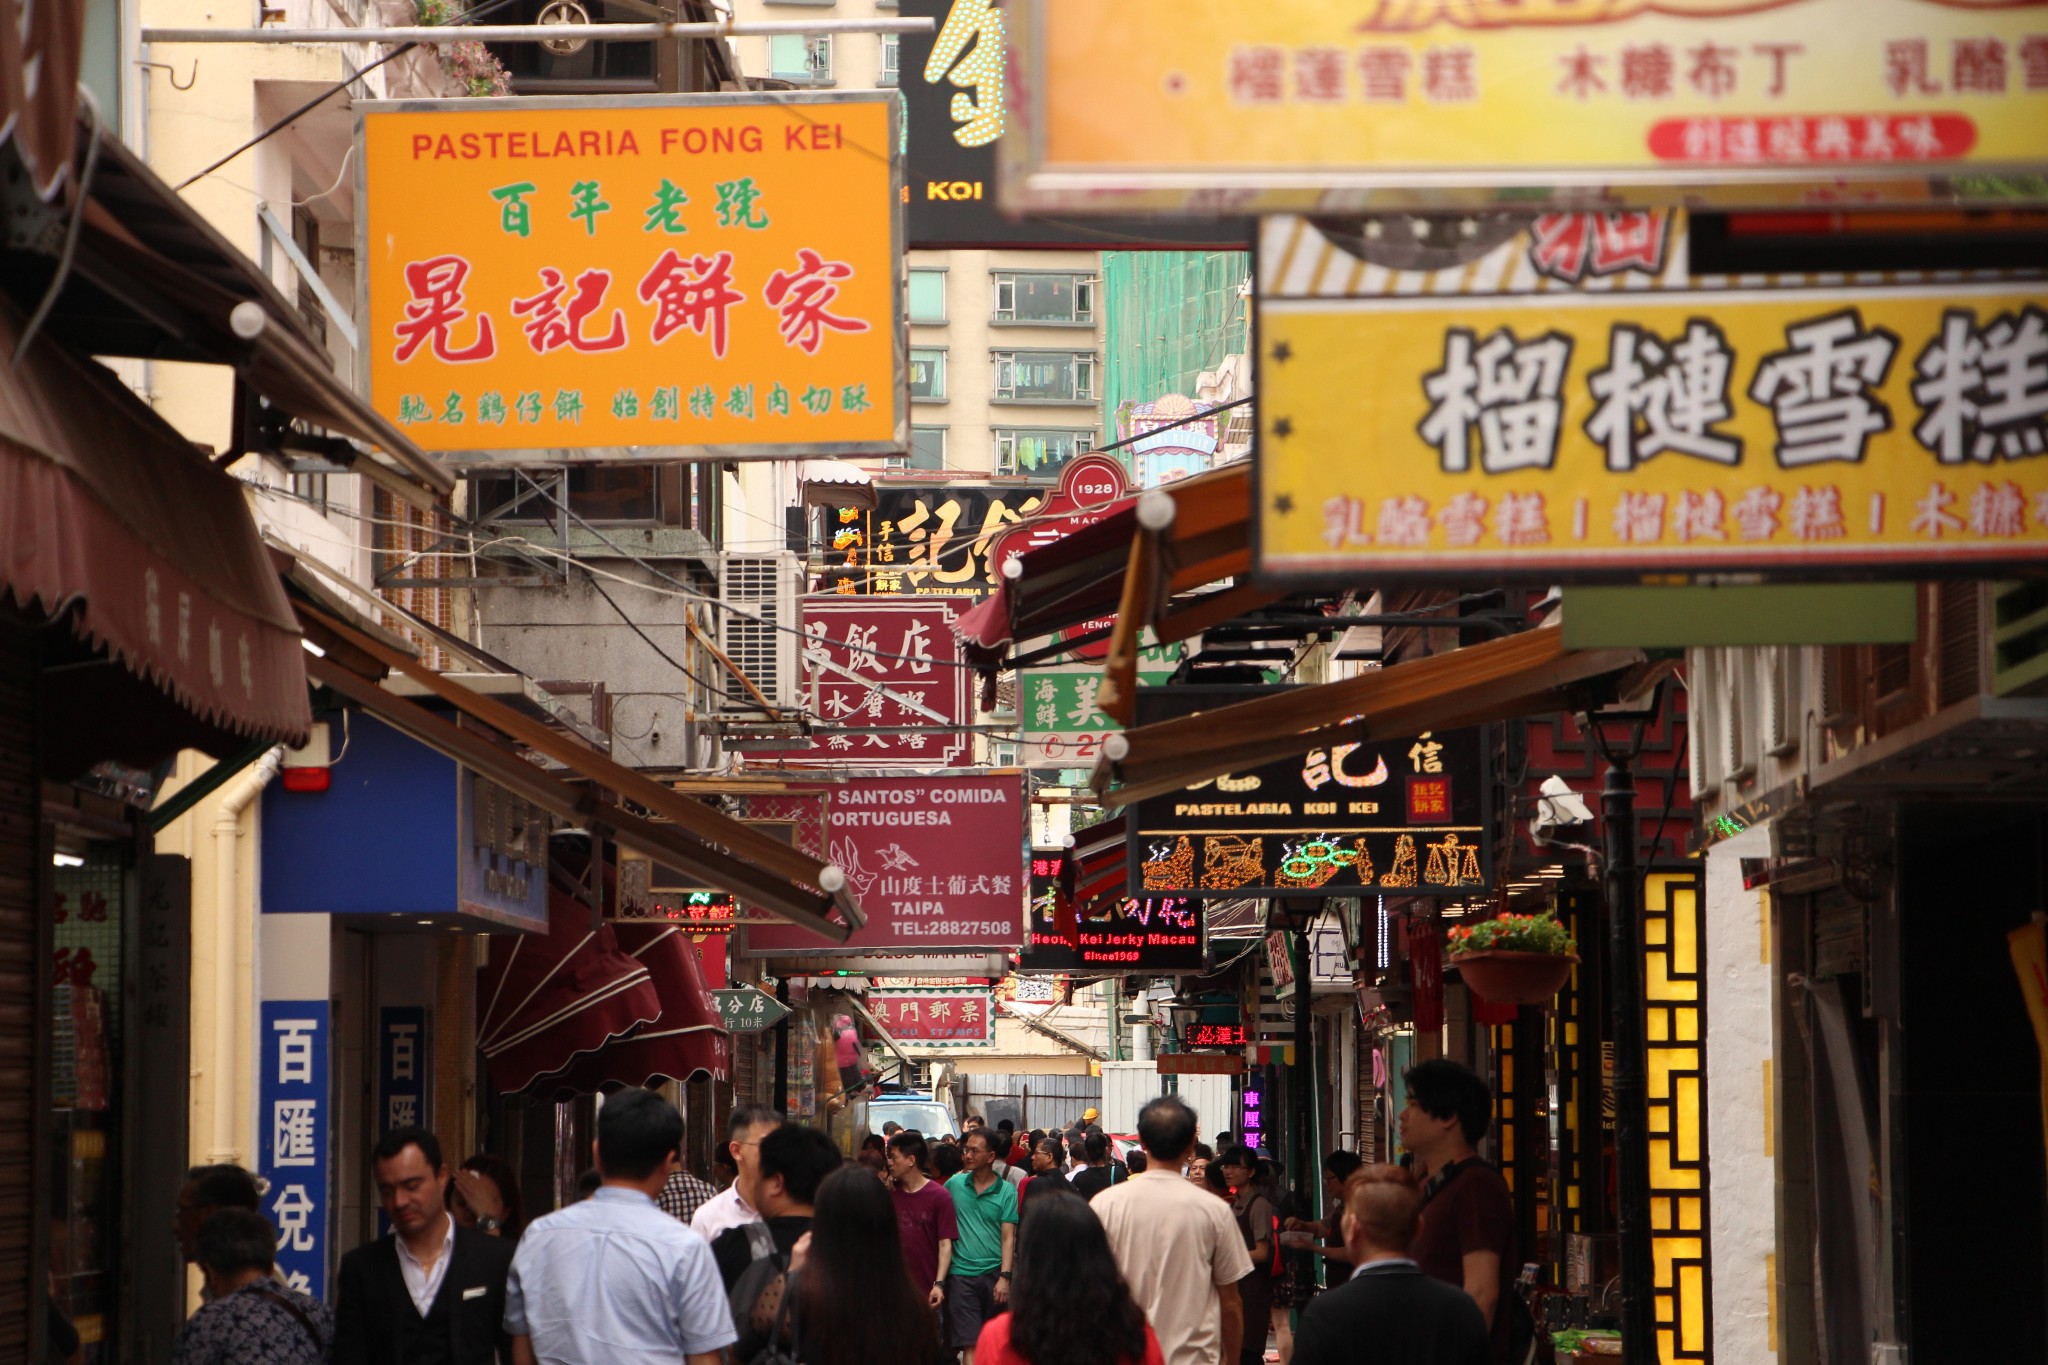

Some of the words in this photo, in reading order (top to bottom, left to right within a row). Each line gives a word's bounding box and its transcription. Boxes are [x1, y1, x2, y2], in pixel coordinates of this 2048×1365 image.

[412, 129, 640, 160] PASTELARIA
[660, 126, 763, 155] FONG
[784, 123, 844, 151] KEI
[927, 181, 983, 201] KOI
[490, 177, 770, 237] 百年老號
[394, 248, 871, 364] 晃記餅家
[1078, 483, 1113, 495] 1928
[1911, 480, 2048, 541] 木糠
[1070, 516, 1108, 525] MAC
[1034, 678, 1060, 730] 海鮮
[929, 788, 1007, 804] COMIDA
[1175, 802, 1292, 817] PASTELARIA
[1303, 802, 1338, 815] KOI
[1348, 801, 1379, 814] KEI
[880, 875, 1012, 897] 山度士葡式餐
[891, 901, 945, 916] TAIPA
[891, 921, 1012, 936] TEL:28827508
[1079, 933, 1103, 946] Kei
[1106, 933, 1145, 948] Jerky
[1148, 933, 1197, 946] Macau
[869, 1000, 980, 1024] 澳門郵票
[930, 1027, 980, 1037] STAMPS
